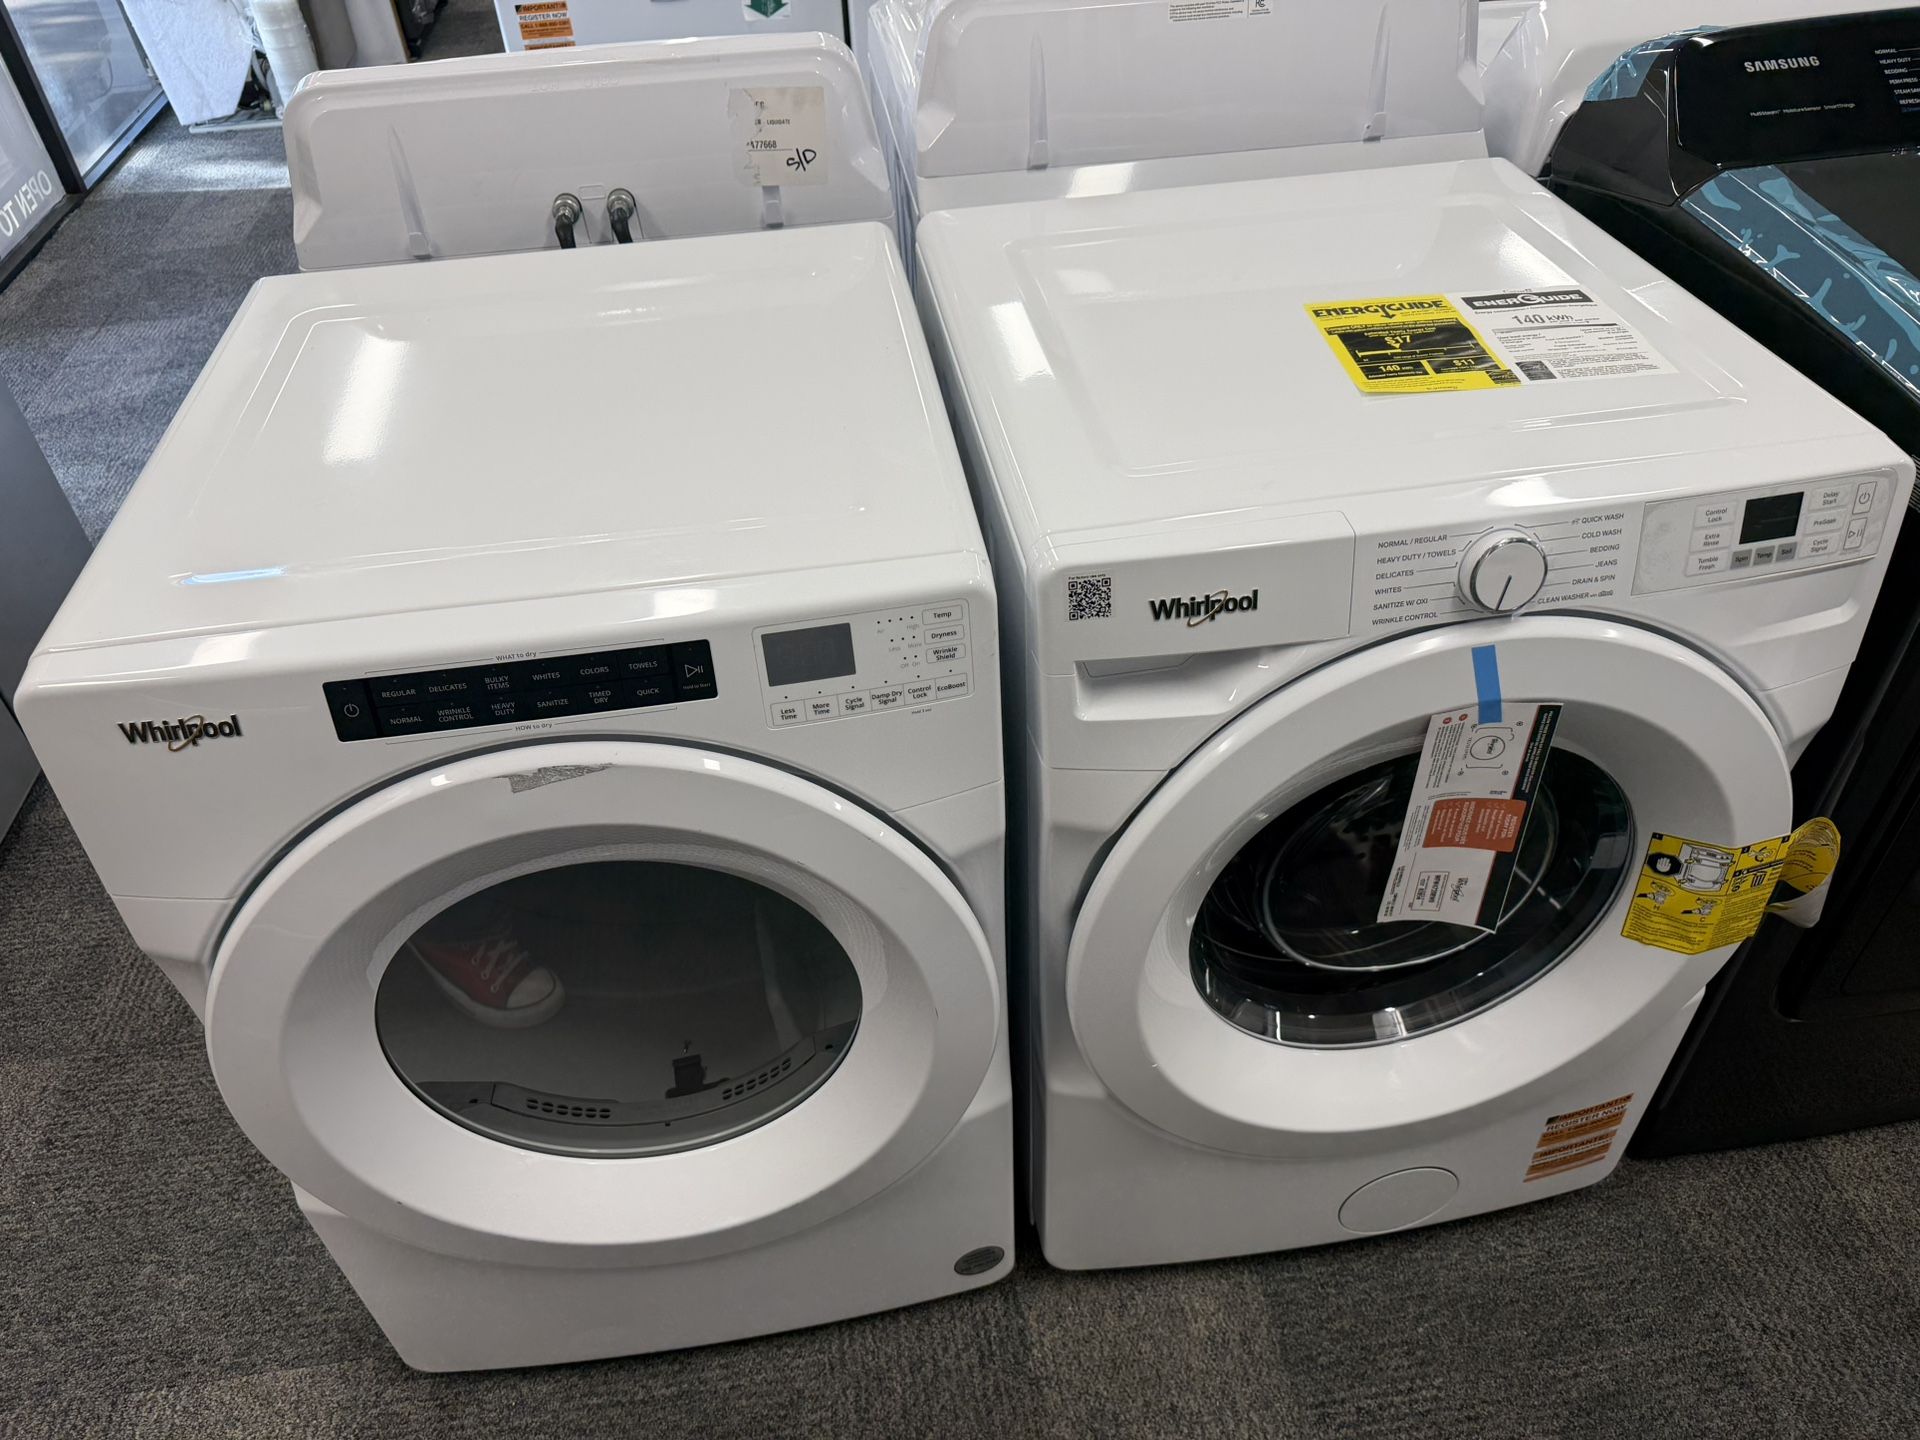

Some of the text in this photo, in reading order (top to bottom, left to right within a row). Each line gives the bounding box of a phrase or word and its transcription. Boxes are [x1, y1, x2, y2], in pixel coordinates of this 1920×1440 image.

[1744, 56, 1820, 73] SAMSUNG
[1313, 300, 1447, 318] ENERGYGUIDE
[1512, 314, 1545, 325] 140
[1546, 314, 1573, 322] kWh
[1385, 335, 1412, 346] $17
[1452, 358, 1476, 367] $11
[1379, 364, 1400, 373] 140
[1822, 498, 1837, 506] Start
[1705, 507, 1728, 516] Control
[1581, 515, 1602, 524] QUICK
[1581, 528, 1622, 539] COLD WASH
[1378, 540, 1408, 549] NORMAL
[1414, 535, 1448, 544] REGULAR
[1589, 543, 1620, 553] BEDDING
[1781, 548, 1793, 556] Soil
[1811, 545, 1828, 553] Signal
[1377, 557, 1401, 565] HEAVY
[1402, 553, 1421, 561] DUTY
[1427, 549, 1457, 558] TOWELS
[1595, 559, 1618, 568] JEANS
[1376, 569, 1414, 580] DELICATES
[1571, 577, 1593, 586] DRAIN
[1600, 574, 1616, 582] SPIN
[1375, 586, 1402, 595] WHITES
[1537, 596, 1560, 604] CLEAN
[1560, 592, 1590, 601] WASHER
[1150, 589, 1259, 621] Whirlpool
[1373, 600, 1405, 611] SANITIZE
[1372, 612, 1439, 626] WRINKLE CONTROL
[931, 630, 957, 639] Dryness
[933, 646, 958, 655] Wrinkle
[495, 654, 516, 662] WHAT
[525, 651, 537, 659] dry
[936, 653, 956, 661] Shield
[628, 660, 658, 671] TOWELS
[532, 671, 561, 681] WHITES
[580, 666, 610, 676] COLORS
[484, 675, 509, 684] BULKY
[428, 683, 468, 693] DELICATES
[487, 682, 510, 690] ITEMS
[907, 685, 932, 694] Control
[936, 682, 966, 692] EcoBoost
[381, 688, 416, 698] REGULAR
[588, 690, 611, 698] TIMED
[636, 688, 660, 696] QUICK
[871, 692, 891, 700] Damp
[491, 702, 515, 710] HEAVY
[536, 698, 569, 708] SANITIZE
[594, 697, 609, 705] DRY
[812, 702, 830, 710] More
[845, 697, 863, 705] Cycle
[878, 697, 897, 705] Signal
[437, 706, 471, 716] WRINKLE
[845, 703, 865, 711] Signal
[438, 713, 474, 723] CONTROL
[495, 709, 515, 717] DUTY
[389, 715, 423, 726] NORMAL
[118, 714, 243, 746] Whirlpool
[515, 724, 532, 732] HOW
[541, 721, 553, 730] dry
[1507, 816, 1518, 838] REGISTER
[1547, 1114, 1600, 1131] REGISTER
[1601, 1104, 1627, 1116] NOW
